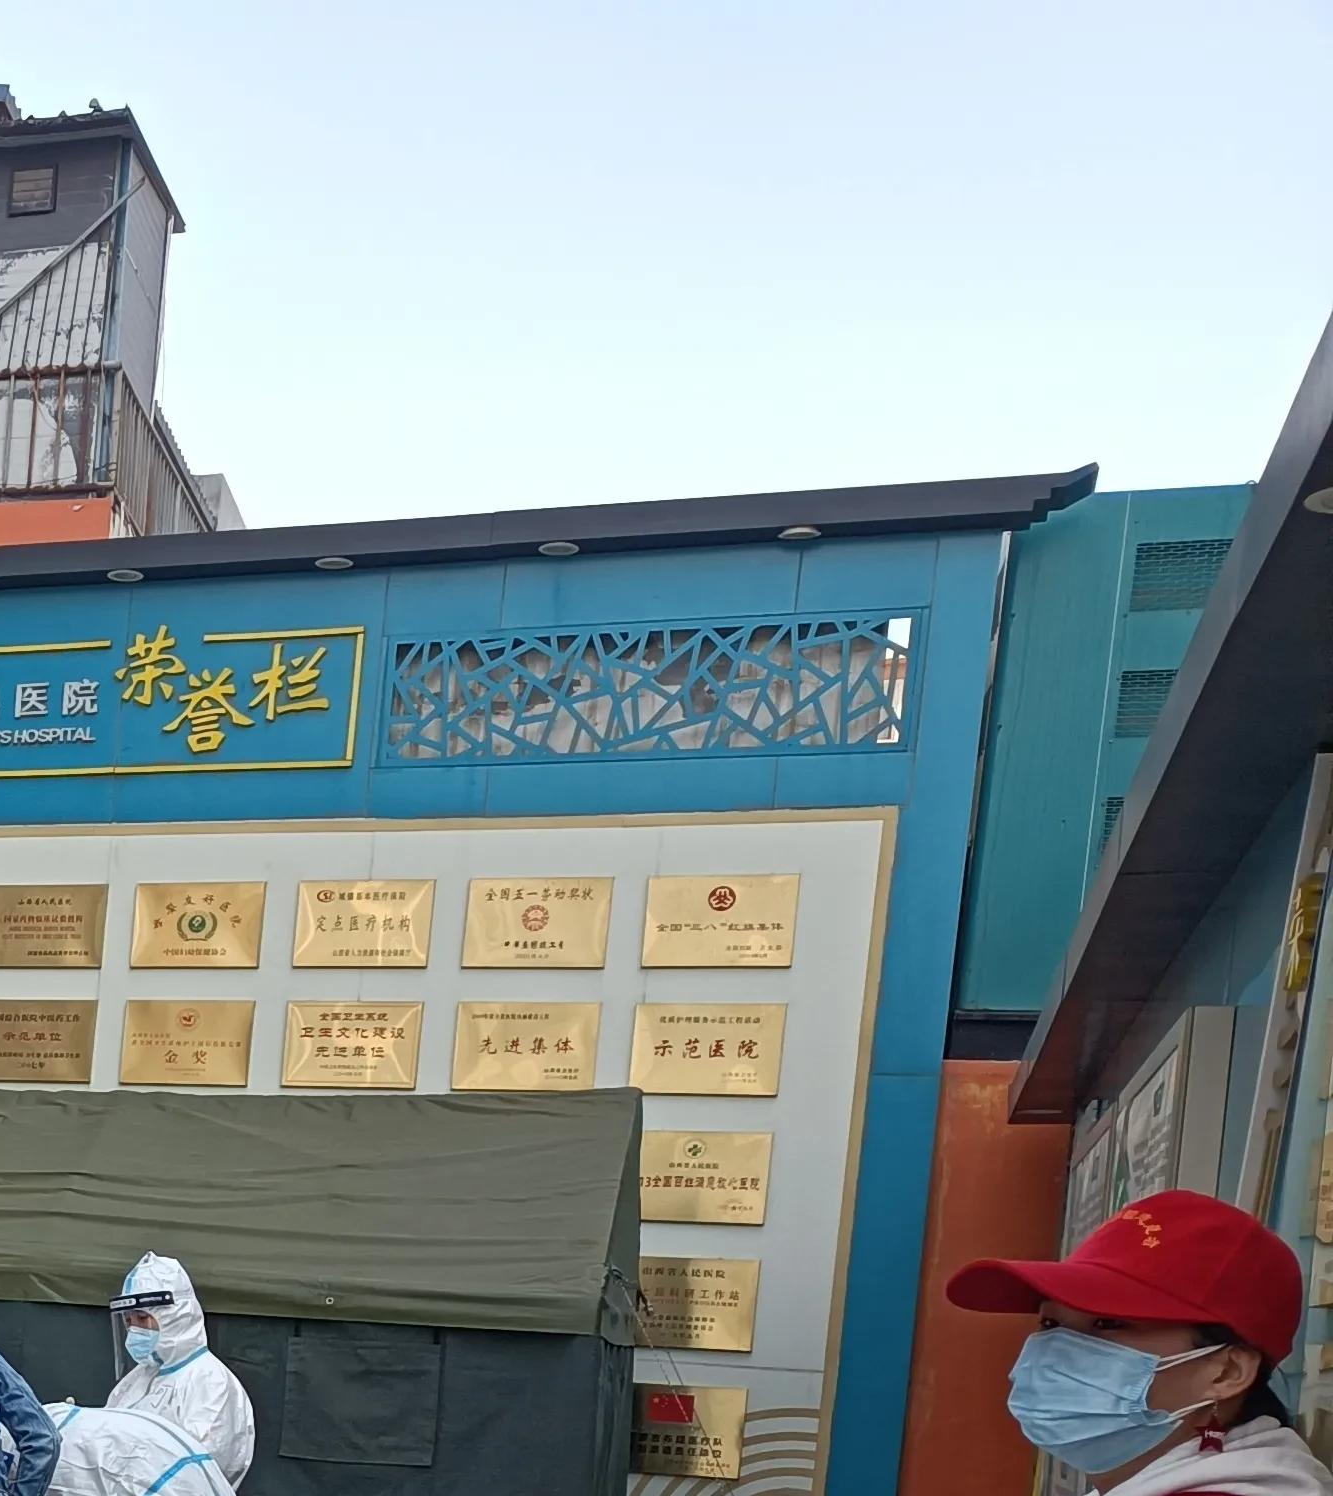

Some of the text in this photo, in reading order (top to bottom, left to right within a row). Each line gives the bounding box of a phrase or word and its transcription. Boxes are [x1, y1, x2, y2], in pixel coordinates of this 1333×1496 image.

[115, 625, 330, 754] 荣誉栏
[13, 726, 97, 745] HOSPITAL
[484, 886, 595, 902] 全国五一劳动奖状
[315, 914, 413, 934] 定点医疗机构
[2, 1030, 64, 1042] 示范单位
[300, 1026, 406, 1040] 卫生文化建设
[314, 1045, 386, 1058] 先进单位
[478, 1036, 576, 1056] 先进集体
[653, 1037, 761, 1060] 示范医院
[163, 1049, 208, 1065] 金奖
[642, 1267, 726, 1279] 山西省人民医院
